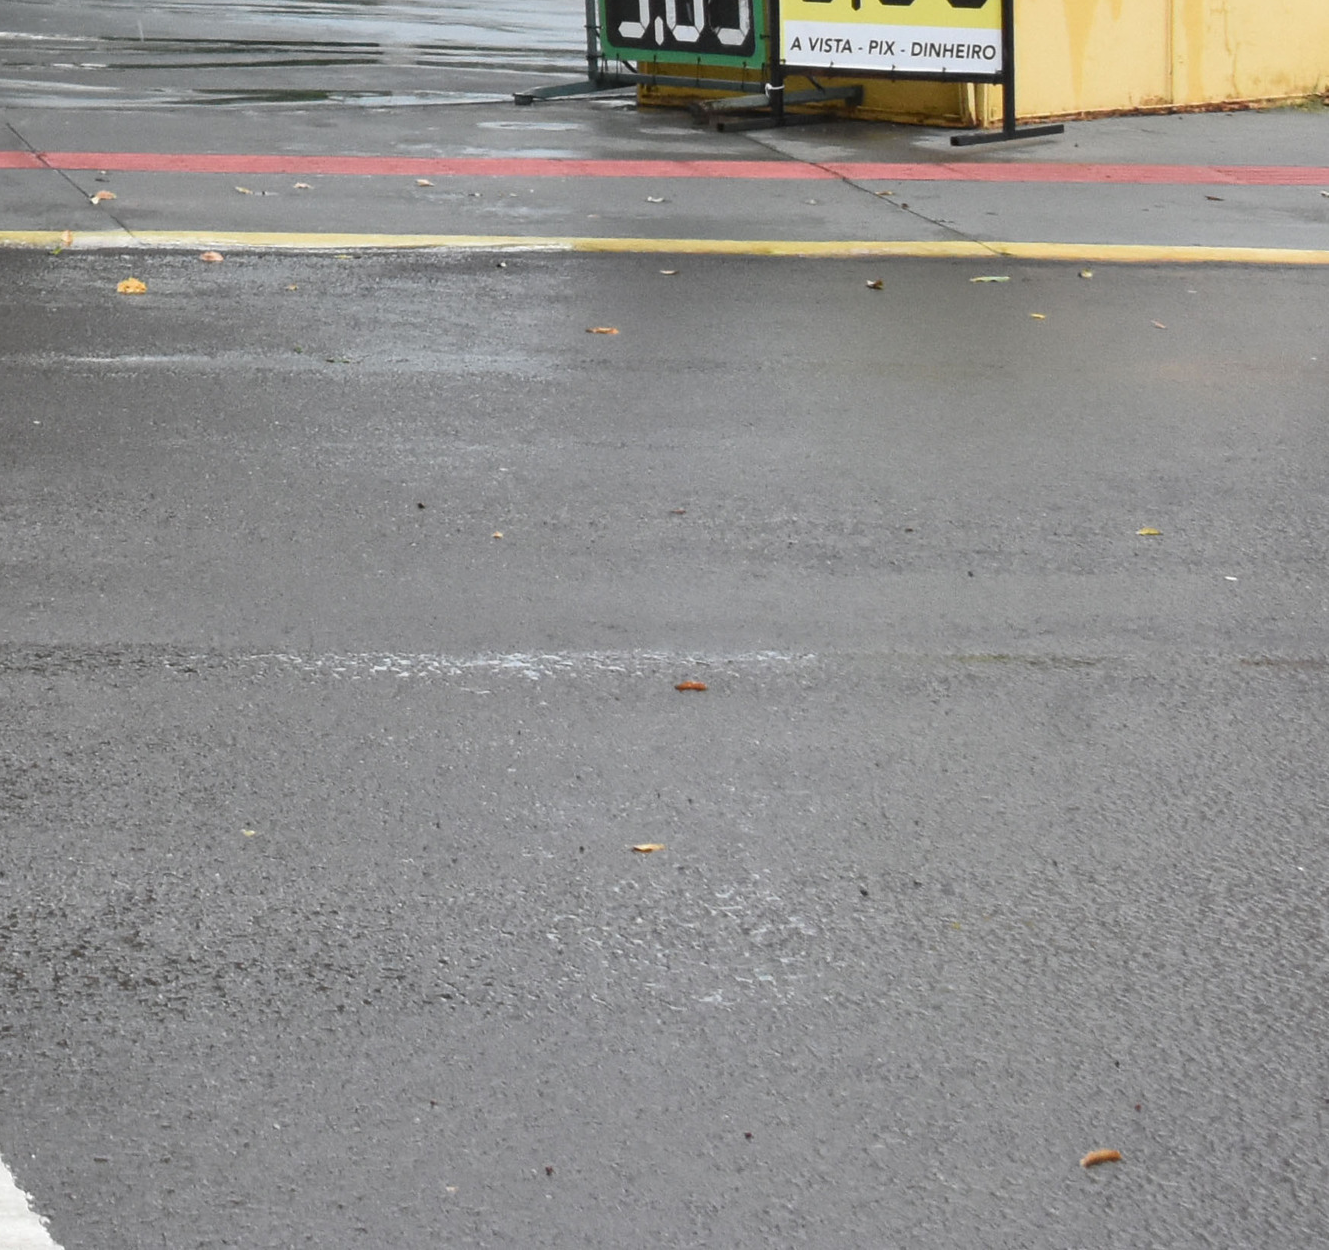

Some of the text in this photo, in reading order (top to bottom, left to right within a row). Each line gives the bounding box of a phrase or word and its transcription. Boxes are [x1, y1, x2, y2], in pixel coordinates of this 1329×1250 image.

[791, 36, 802, 51] A
[808, 37, 853, 54] VISTA
[868, 40, 896, 56] PIX
[910, 42, 997, 60] DINHEIRO
